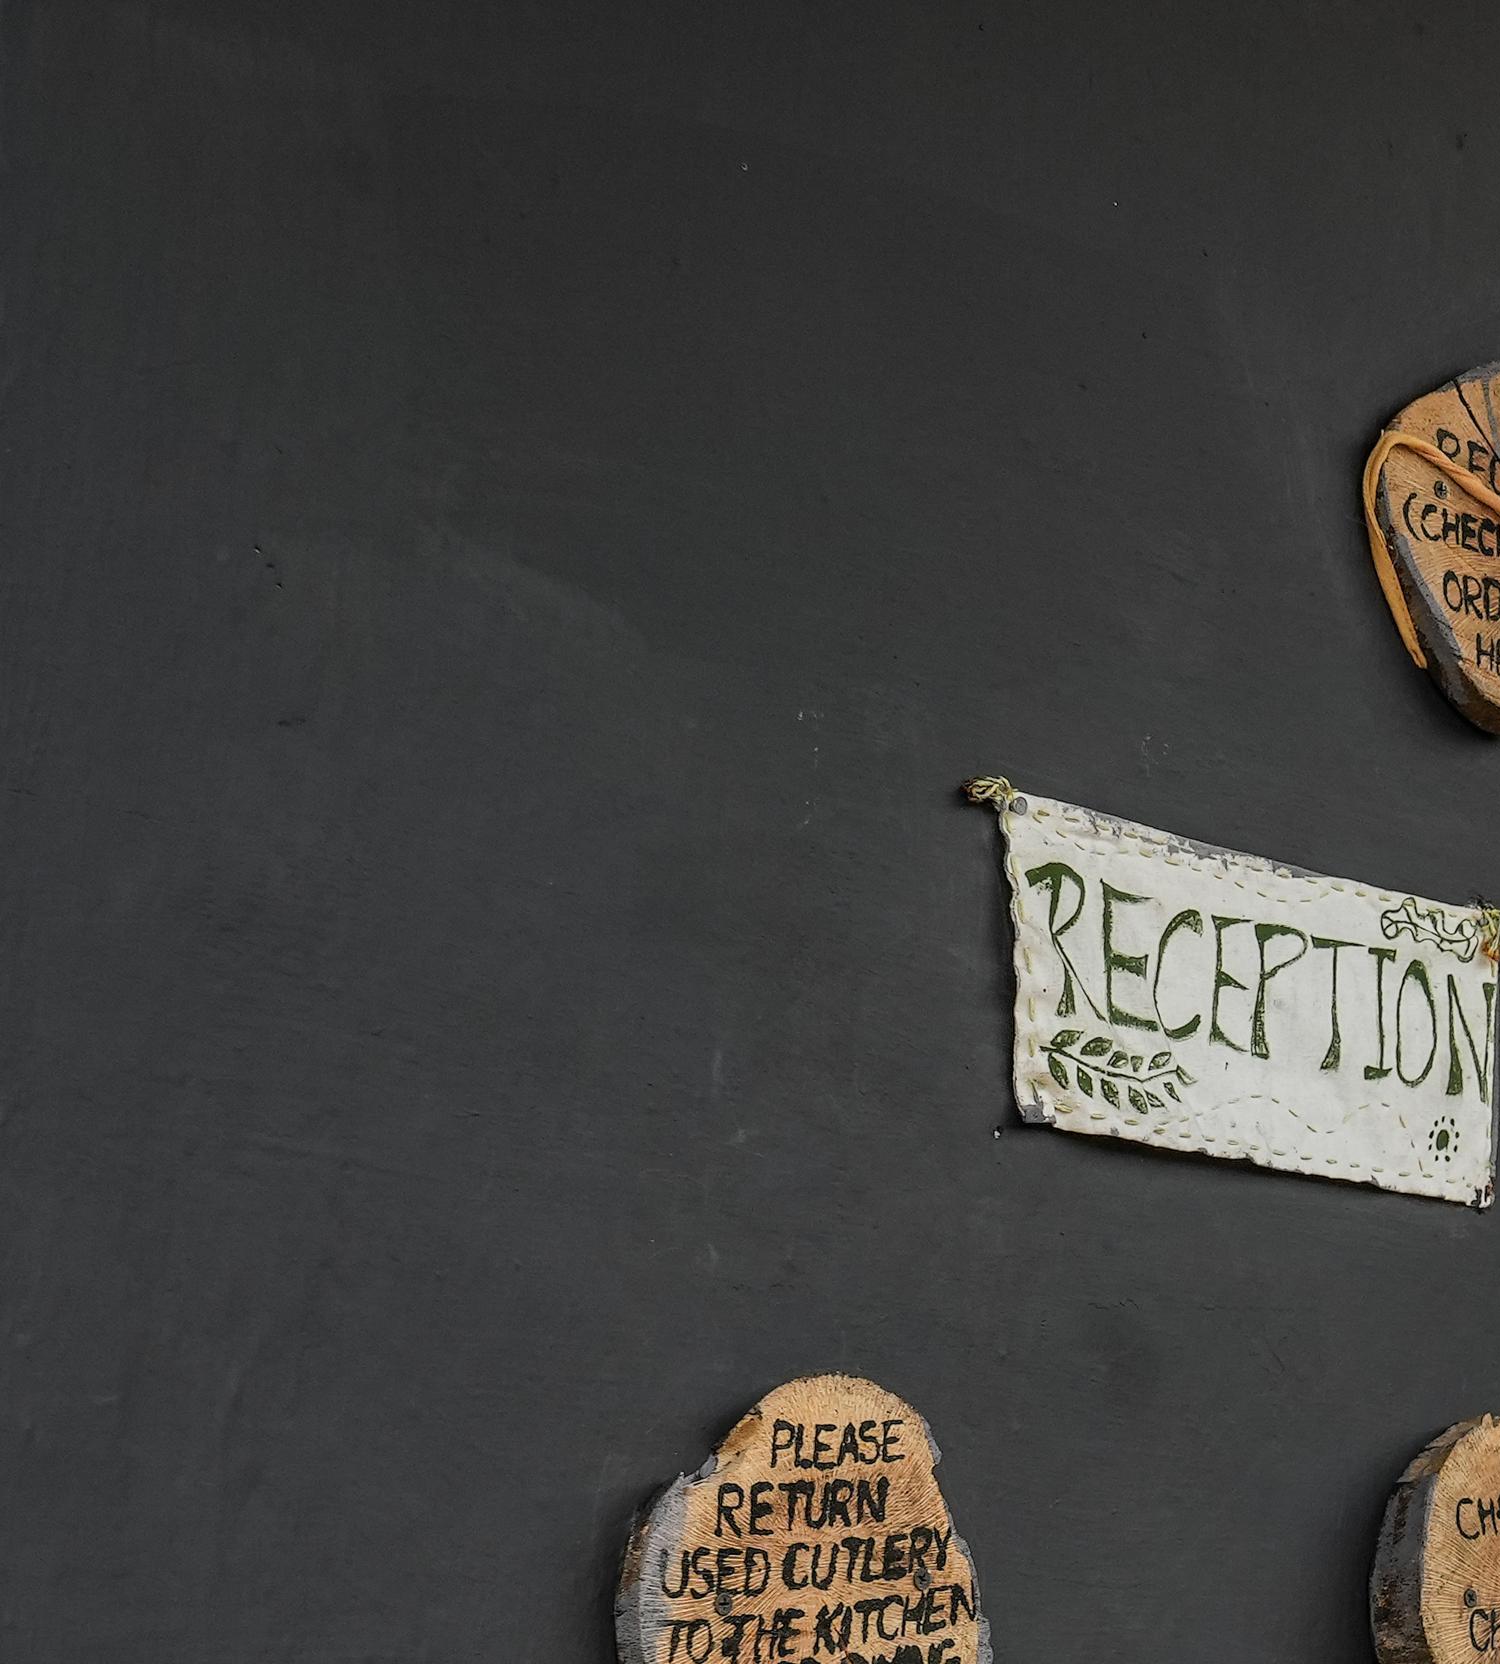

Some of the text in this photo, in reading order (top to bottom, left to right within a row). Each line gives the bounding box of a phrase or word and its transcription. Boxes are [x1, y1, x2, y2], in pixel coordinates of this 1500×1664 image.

[1025, 862, 1496, 1103] RECEPTION
[770, 1418, 906, 1469] PLEASE
[713, 1476, 890, 1538] RETURN
[660, 1526, 953, 1600] USED CUTLERY
[813, 1583, 978, 1656] KITCHEN
